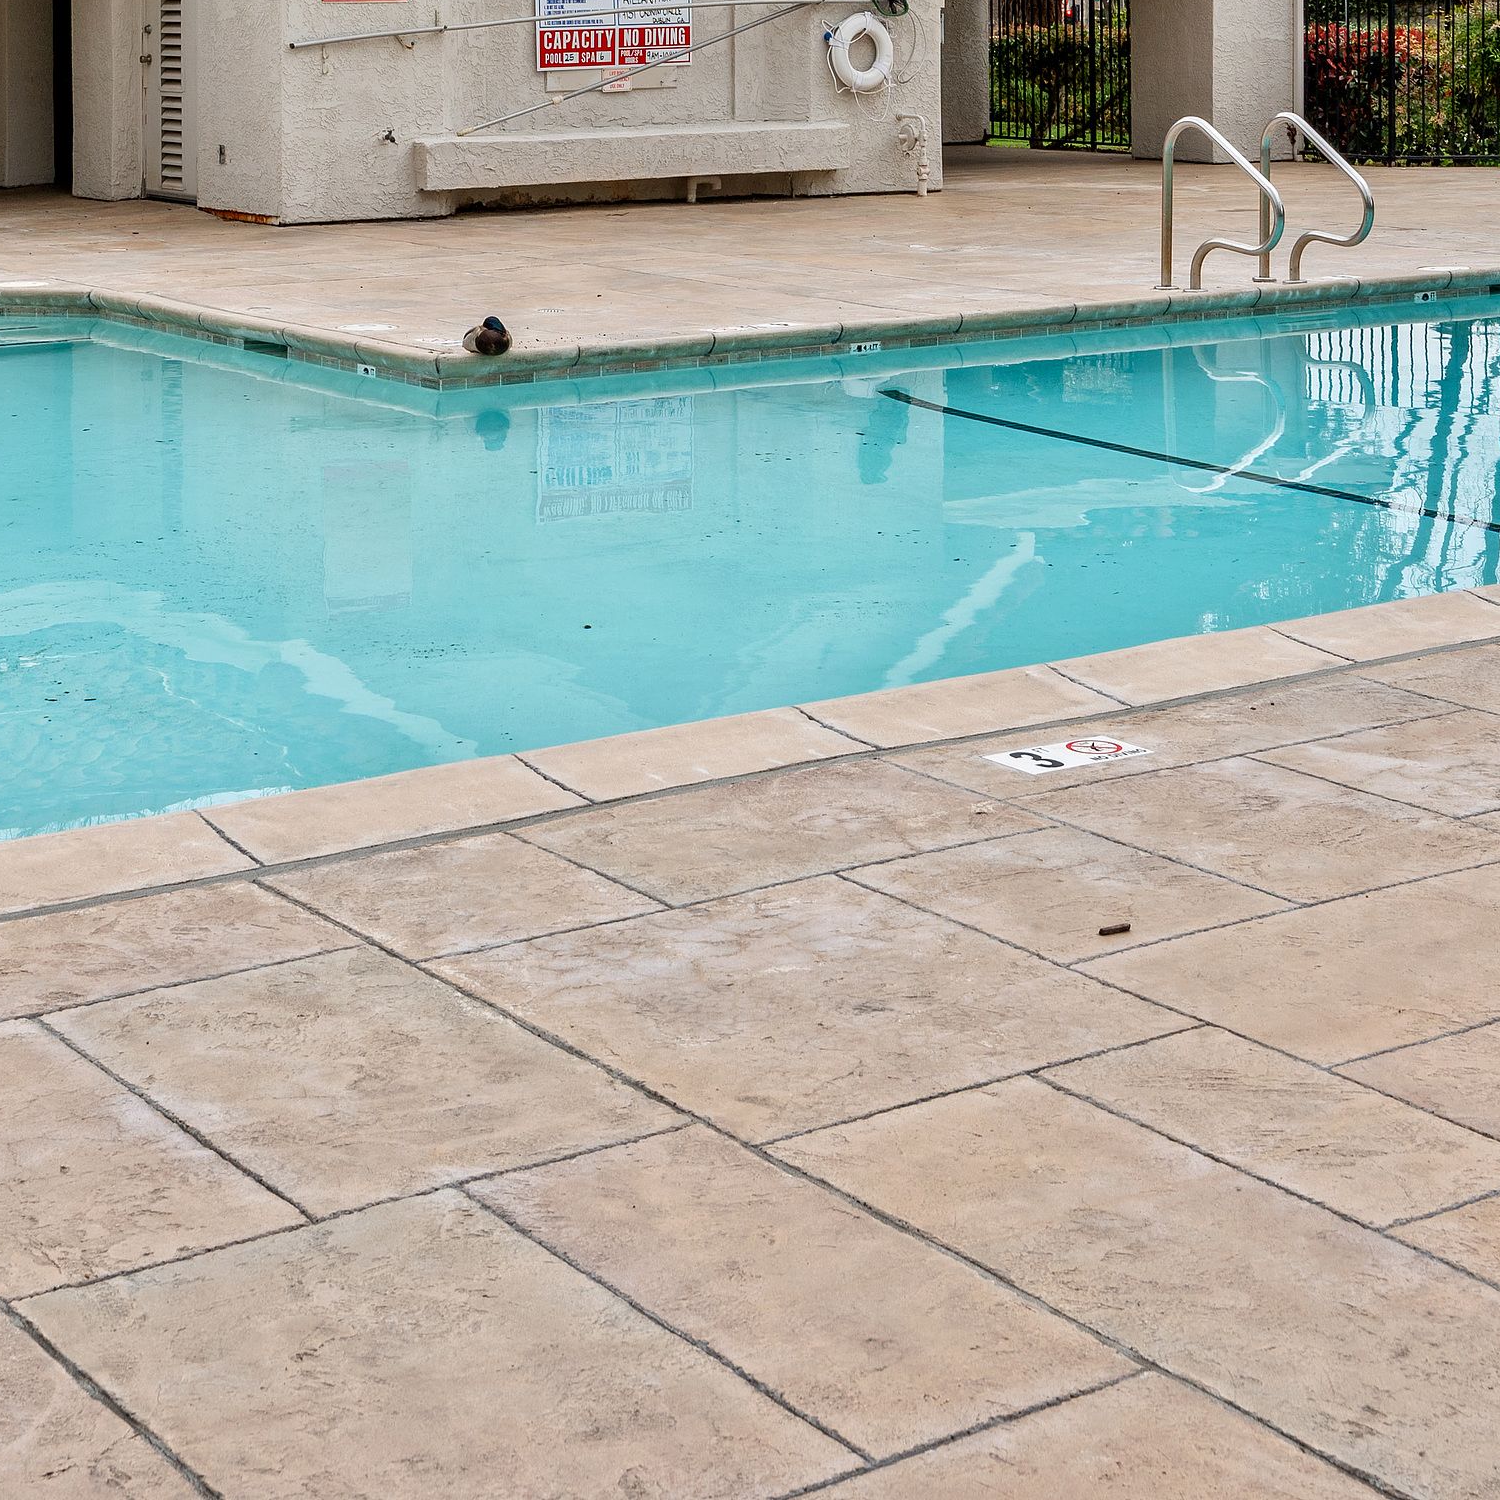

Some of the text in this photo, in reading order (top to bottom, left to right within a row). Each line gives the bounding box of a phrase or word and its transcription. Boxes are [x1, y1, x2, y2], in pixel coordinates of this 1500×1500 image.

[543, 30, 614, 50] CAPACITY
[623, 27, 686, 47] NO DIVING
[545, 52, 605, 64] POOL 25 SPA 6
[620, 49, 643, 57] POOL/SPA
[1009, 751, 1066, 768] 3
